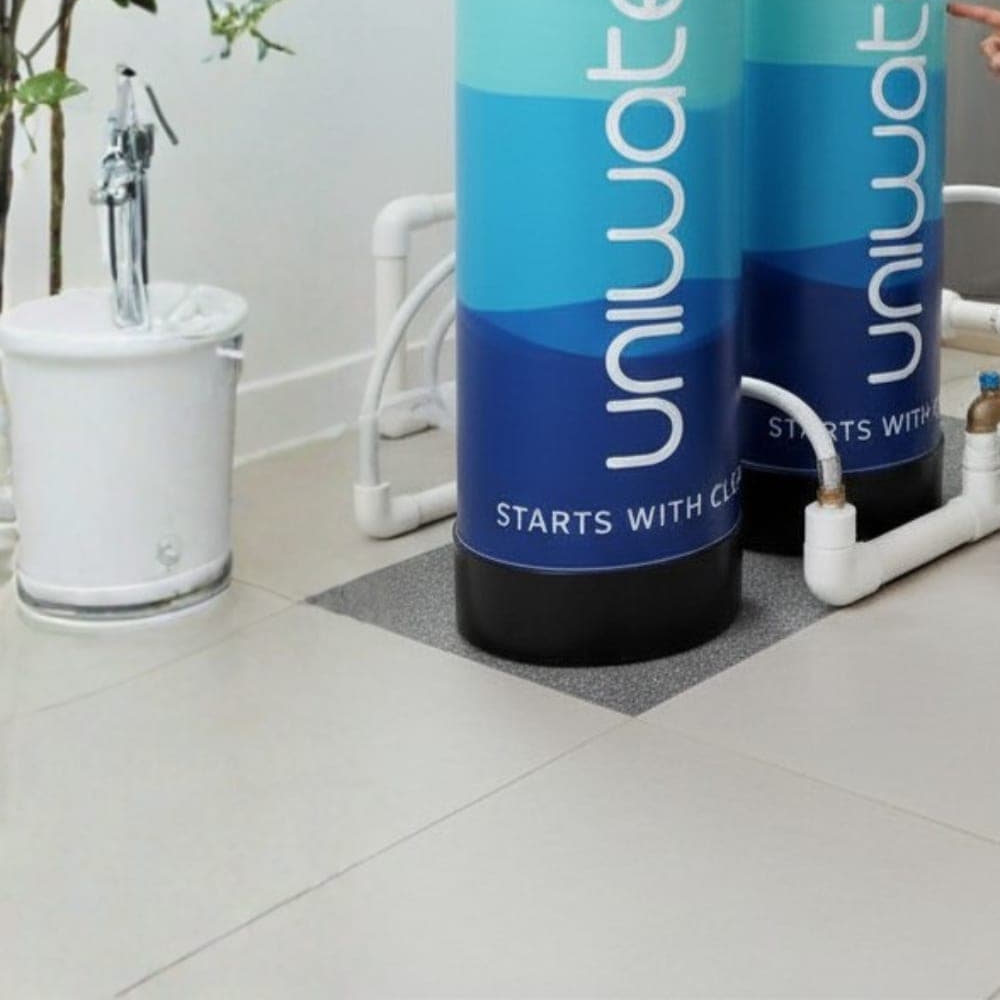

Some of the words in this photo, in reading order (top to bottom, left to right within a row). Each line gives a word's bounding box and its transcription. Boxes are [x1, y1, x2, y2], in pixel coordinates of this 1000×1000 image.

[768, 416, 872, 442] STRTS
[882, 403, 931, 437] WITH
[496, 502, 613, 535] STARTS
[627, 492, 702, 532] WITH
